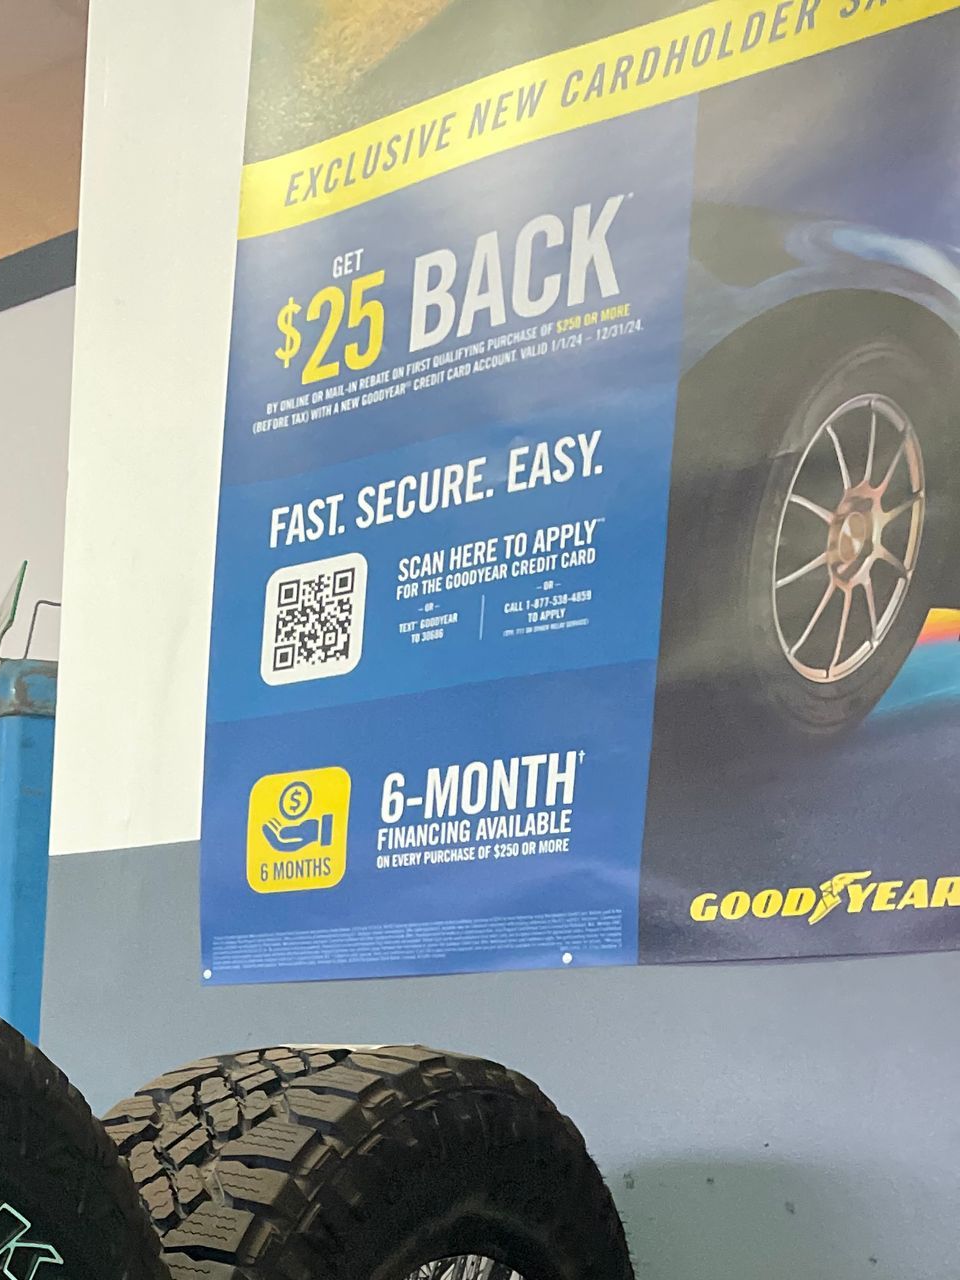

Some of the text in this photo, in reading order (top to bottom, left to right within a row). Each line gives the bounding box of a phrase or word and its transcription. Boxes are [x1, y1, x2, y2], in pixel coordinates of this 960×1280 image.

[284, 0, 822, 207] EXCLUSIVE NEW CARDHOLDER
[333, 248, 364, 279] GET
[274, 269, 385, 385] $25
[266, 402, 279, 415] BY
[280, 394, 310, 412] ONLINE
[311, 389, 323, 404] OR
[325, 380, 358, 400] MAIL-IN
[359, 373, 390, 394] REBATE
[392, 367, 405, 380] ON
[406, 357, 432, 377] FIRST
[432, 340, 485, 368] QUALIFYING
[487, 326, 537, 351] PURCHASE
[540, 322, 553, 337] OF
[583, 311, 598, 326] OR
[600, 303, 631, 322] MORE
[252, 414, 290, 435] (BEFORE
[291, 410, 309, 426] TAX)
[310, 404, 332, 421] WITH
[333, 402, 339, 414] A
[340, 396, 360, 412] NEW
[413, 369, 443, 391] CREDIT
[447, 362, 471, 381] CARD
[520, 342, 548, 360] VALID
[551, 333, 583, 351] 1/1/24
[269, 430, 603, 548] FAST. SECURE. EASY.
[396, 547, 596, 601] FOR THE GOODYEAR CREDIT CARD
[398, 550, 444, 582] SCAN
[449, 538, 498, 571] HERE
[503, 532, 527, 560] TO
[420, 612, 458, 630] GOODYEAR
[504, 601, 524, 613] CALL
[528, 607, 566, 623] TO APPLY
[411, 633, 421, 643] TO
[377, 809, 572, 851] FINANCING AVAILABLE
[260, 856, 331, 882] 6 MONTHS
[377, 838, 570, 869] ON EVERY PURCHASE OF $250 OR MORE
[690, 874, 960, 922] GOODYEAR
